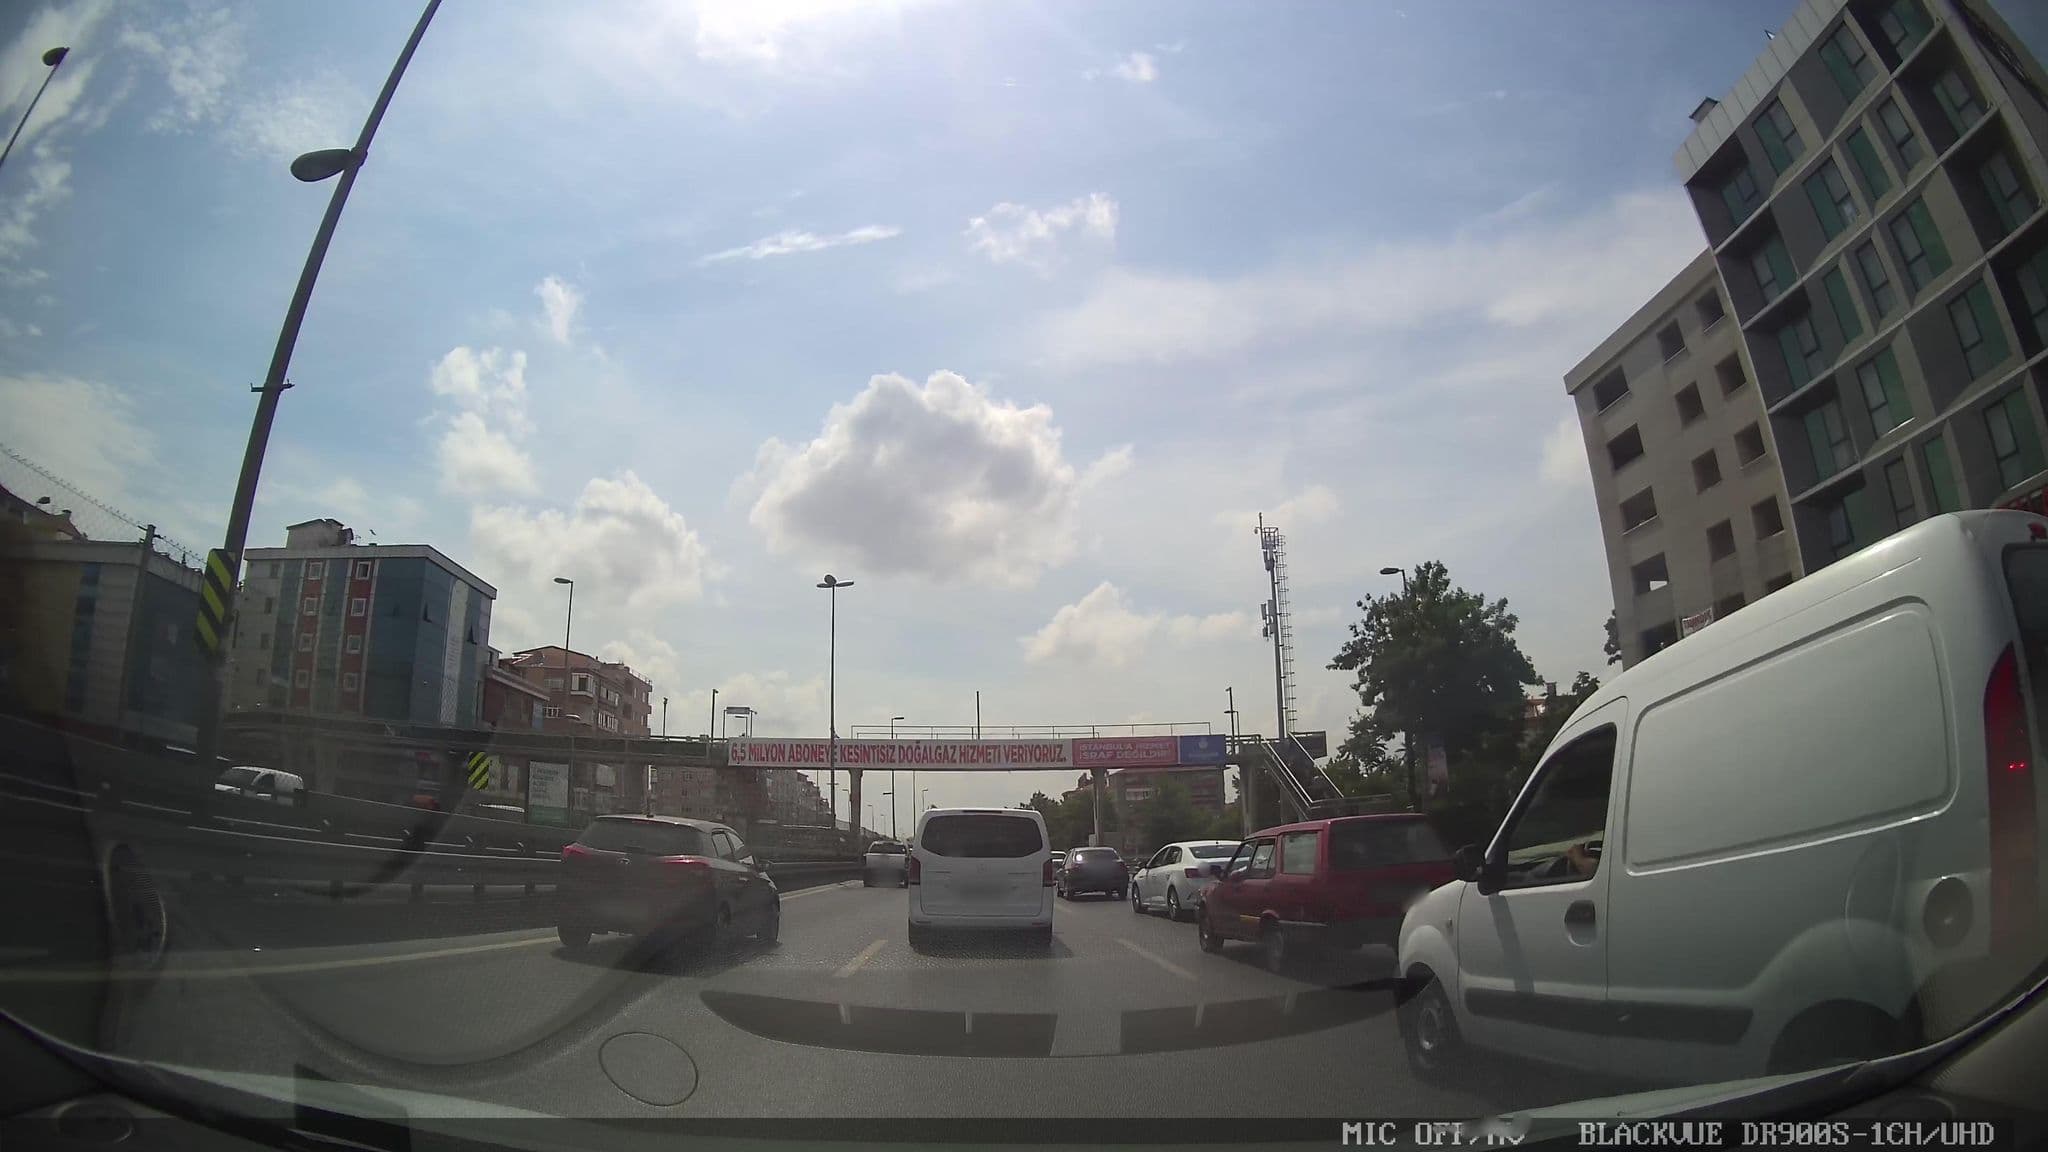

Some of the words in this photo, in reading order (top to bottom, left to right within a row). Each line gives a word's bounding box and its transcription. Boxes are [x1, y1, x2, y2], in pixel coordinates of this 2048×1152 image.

[731, 743, 747, 764] 6,5
[749, 743, 786, 763] MİLYON
[840, 744, 896, 764] KESİNTİSİZ
[899, 740, 957, 764] DOĞALGAZ
[959, 743, 1001, 764] HİZMETİ
